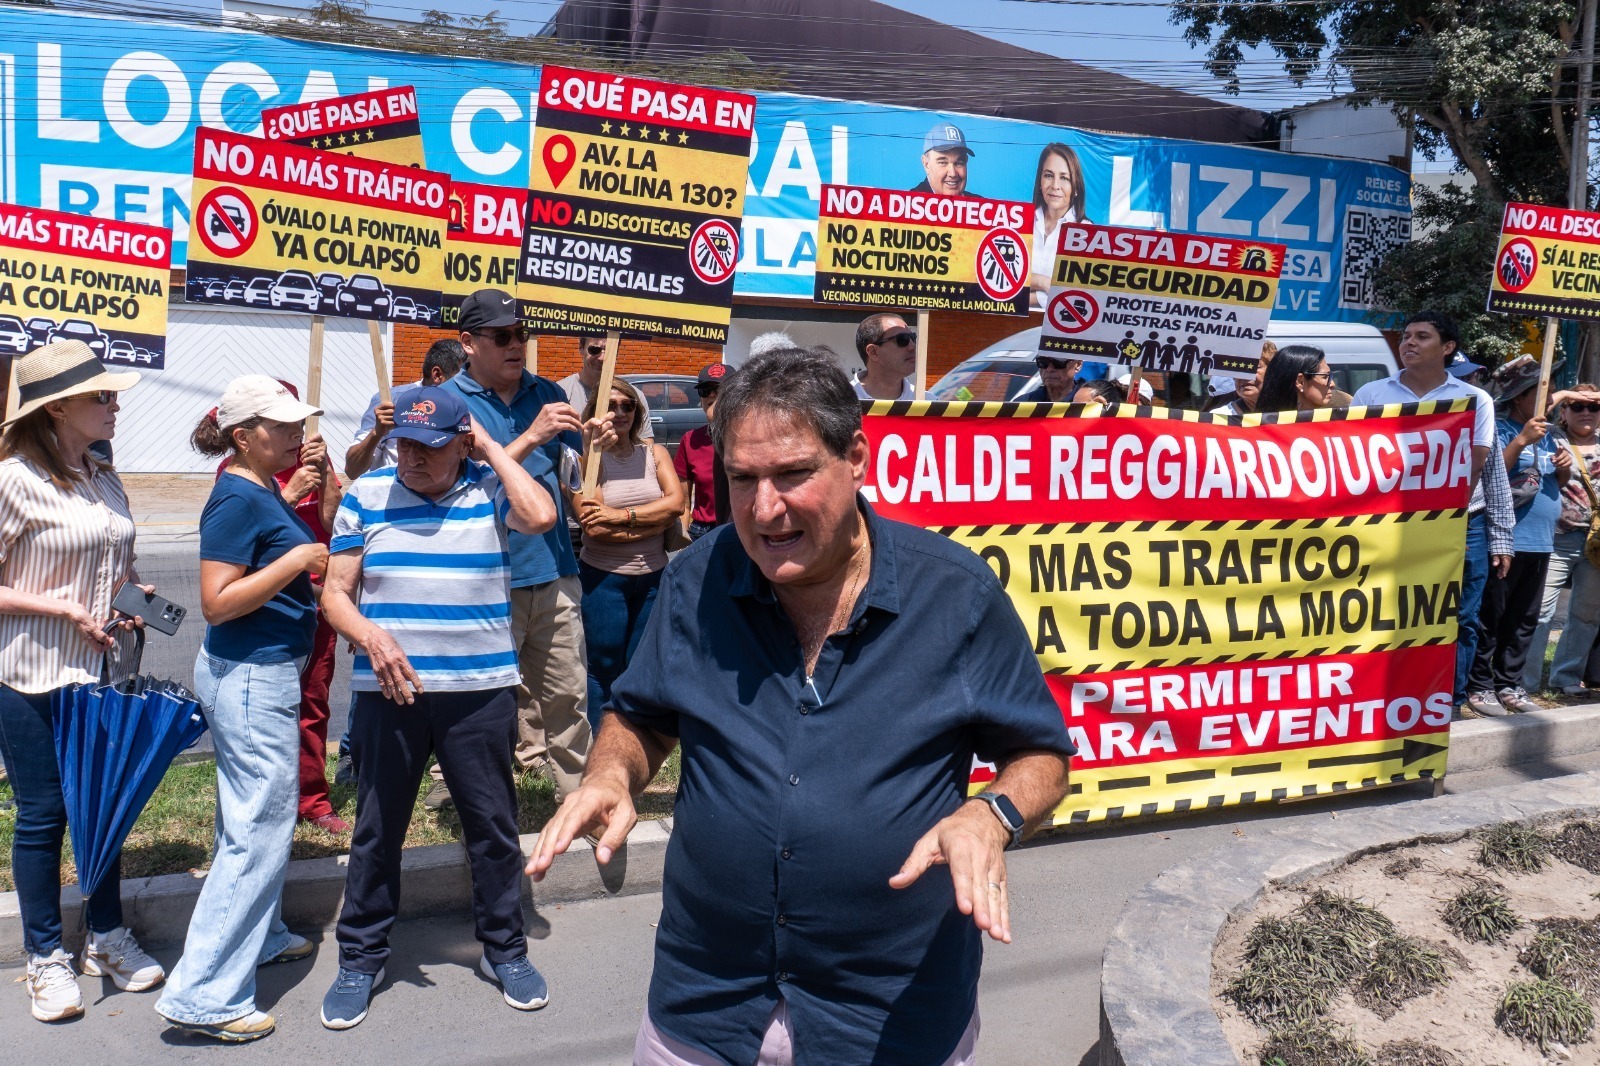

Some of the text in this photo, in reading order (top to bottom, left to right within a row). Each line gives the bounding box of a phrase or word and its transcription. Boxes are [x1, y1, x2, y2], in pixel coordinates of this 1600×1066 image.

[38, 42, 389, 149] LOC
[545, 77, 754, 130] ¿QUÉ PASA EN
[268, 92, 417, 140] ¿QUÉ PASA EN
[202, 138, 444, 209] NO A MÁS TRÁFICO
[582, 142, 658, 173] AV. LA
[579, 168, 738, 210] MOLINA 130?
[1109, 156, 1337, 243] LIZZI
[1356, 189, 1409, 207] SOCIALES
[1366, 176, 1402, 192] REDES
[261, 199, 441, 249] ÓVALO LA FONTANA
[473, 194, 526, 238] BA
[531, 198, 692, 240] NO A DISCOTECAS
[826, 188, 1024, 229] NO A DISCOTECAS
[1506, 208, 1538, 230] NO
[1538, 216, 1557, 232] AL
[0, 212, 166, 260] MÁS TRÁFICO
[271, 231, 421, 274] YA COLAPSÓ
[528, 234, 633, 266] EN ZONAS
[827, 223, 952, 252] NO A RUIDOS
[1064, 227, 1232, 267] BASTA DE
[1541, 244, 1558, 266] SÍ
[1557, 250, 1576, 268] AL
[0, 258, 163, 298] ALO LA FONTANA
[444, 252, 482, 282] NOS
[526, 257, 685, 296] RESIDENCIALES
[832, 247, 949, 276] NOCTURNOS
[1056, 259, 1270, 304] INSEGURIDAD
[1281, 254, 1322, 278] ESA
[0, 282, 140, 320] A COLAPSÓ
[822, 290, 861, 302] VECINOS
[862, 293, 896, 306] UNIDOS
[897, 295, 910, 306] EN
[910, 296, 950, 309] DEFENSA
[962, 300, 974, 310] LA
[974, 300, 1016, 313] MOLINA
[1274, 288, 1322, 312] LVE
[1552, 270, 1600, 294] VECIN
[523, 305, 568, 321] VECINOS
[569, 312, 607, 327] UNIDOS
[608, 316, 621, 328] EN
[622, 318, 663, 333] DEFENSA
[682, 324, 726, 341] MOLINA
[1101, 312, 1264, 341] NUESTRAS FAMILIAS
[1106, 296, 1238, 323] PROTEJAMOS A
[862, 428, 1472, 504] CALDE REGGIARDO/UCEDA
[974, 534, 1370, 592] O MAS TRAFICO,
[1035, 580, 1462, 655] A TODA LA MOLINA
[1070, 661, 1354, 717] PERMITIR
[1067, 692, 1453, 762] ARA EVENTOS
